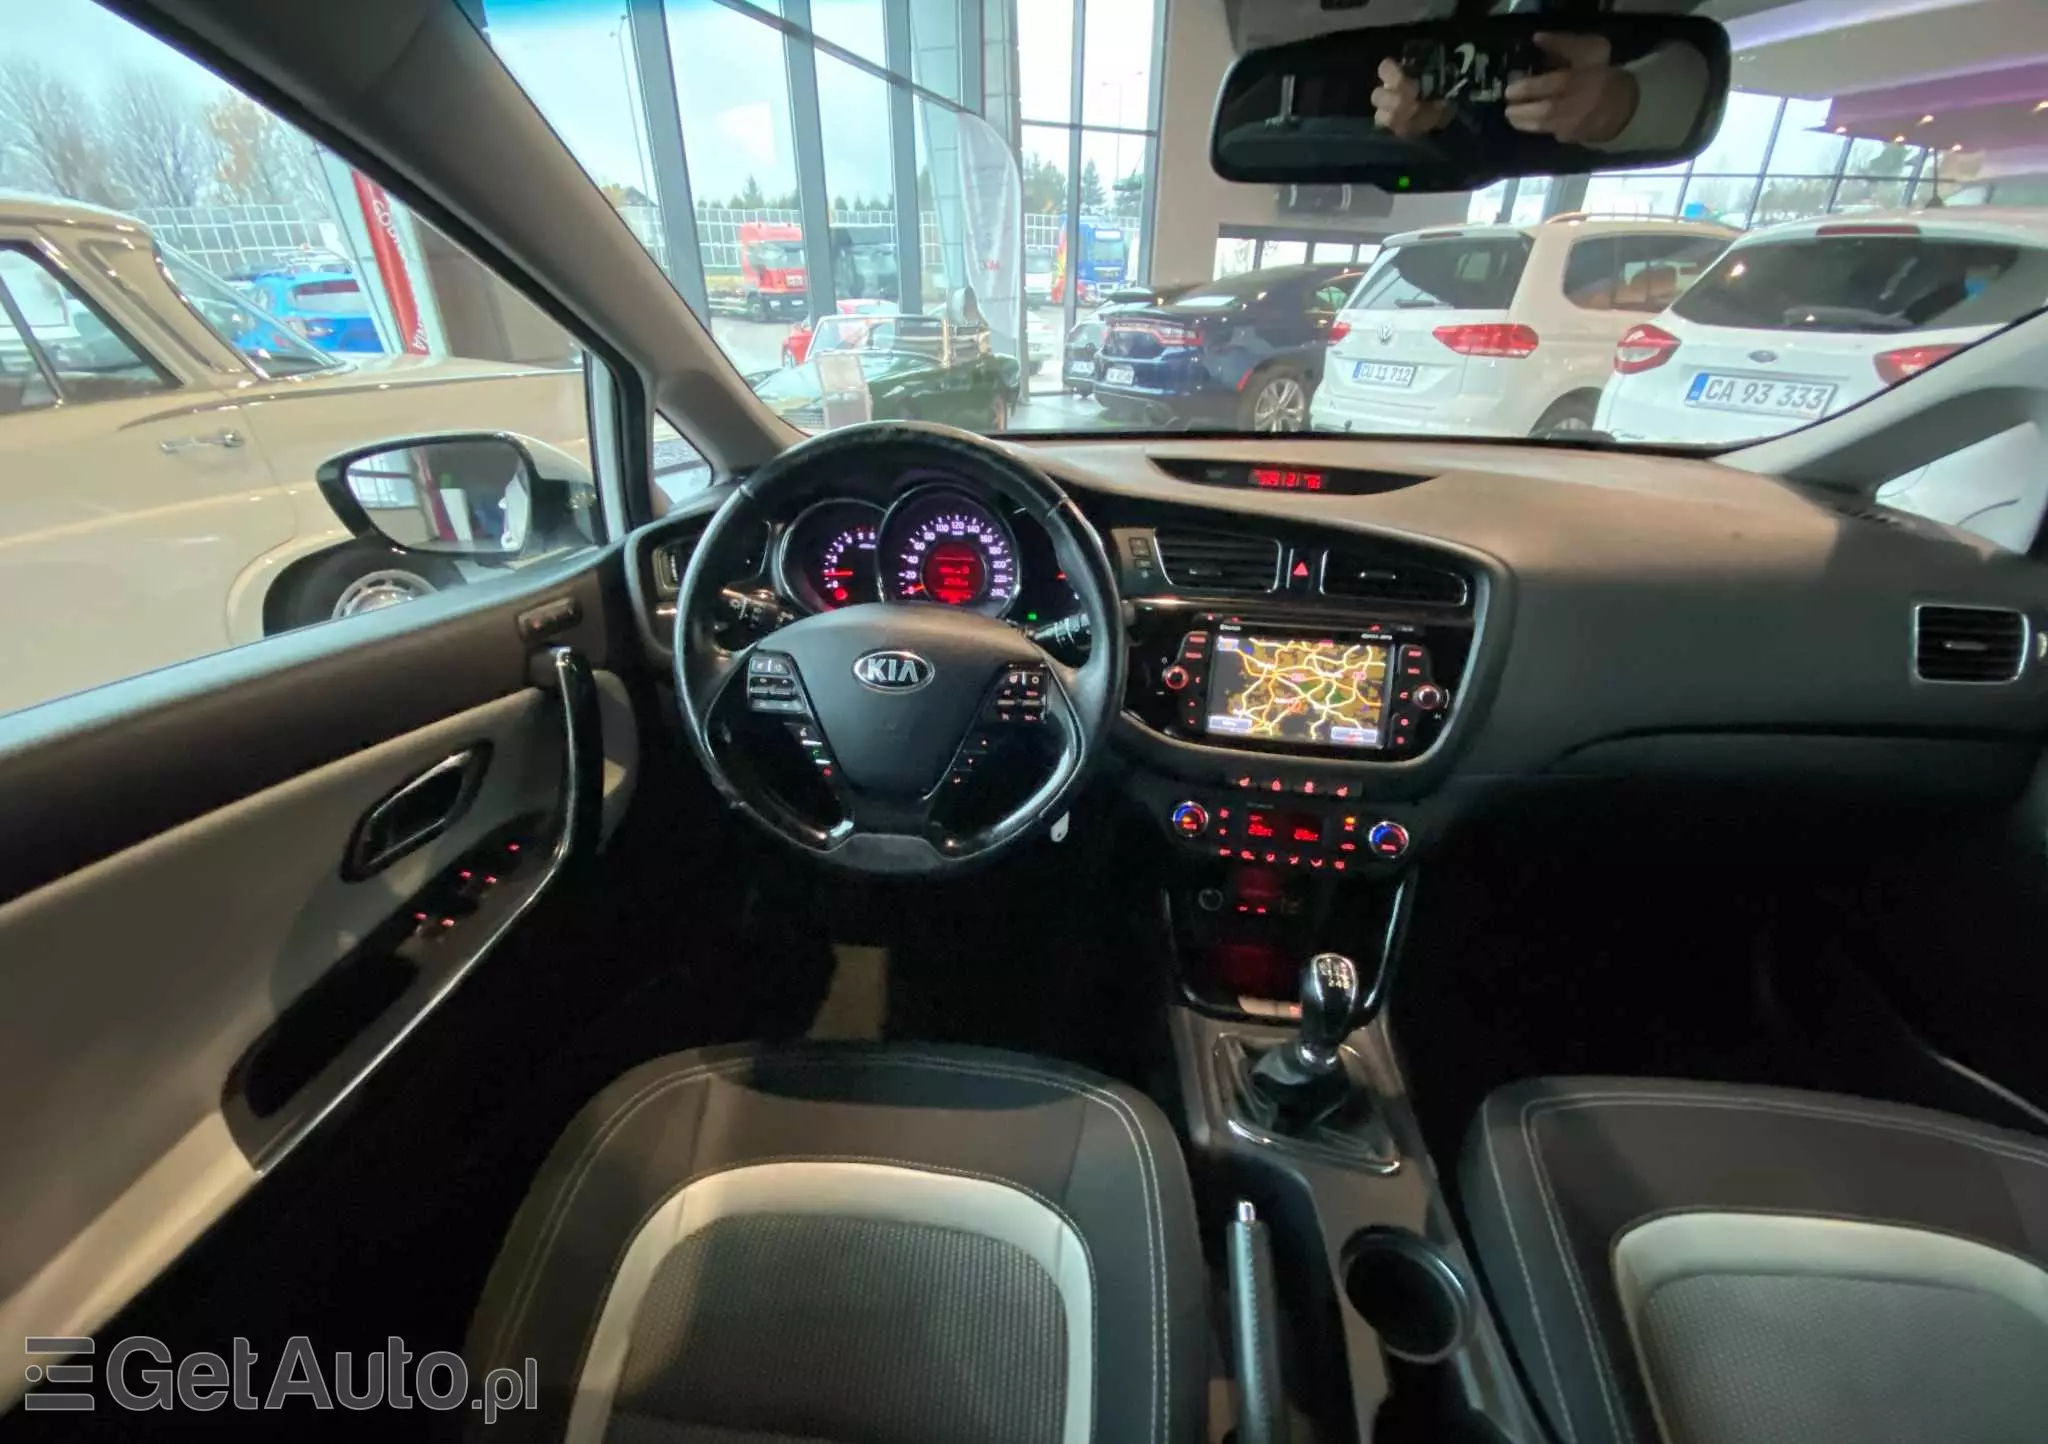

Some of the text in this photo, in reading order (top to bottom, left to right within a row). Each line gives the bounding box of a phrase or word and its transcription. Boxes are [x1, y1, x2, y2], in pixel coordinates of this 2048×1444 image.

[1704, 379, 1828, 409] CA 93 333
[905, 571, 917, 580] 20
[867, 658, 919, 682] KIA
